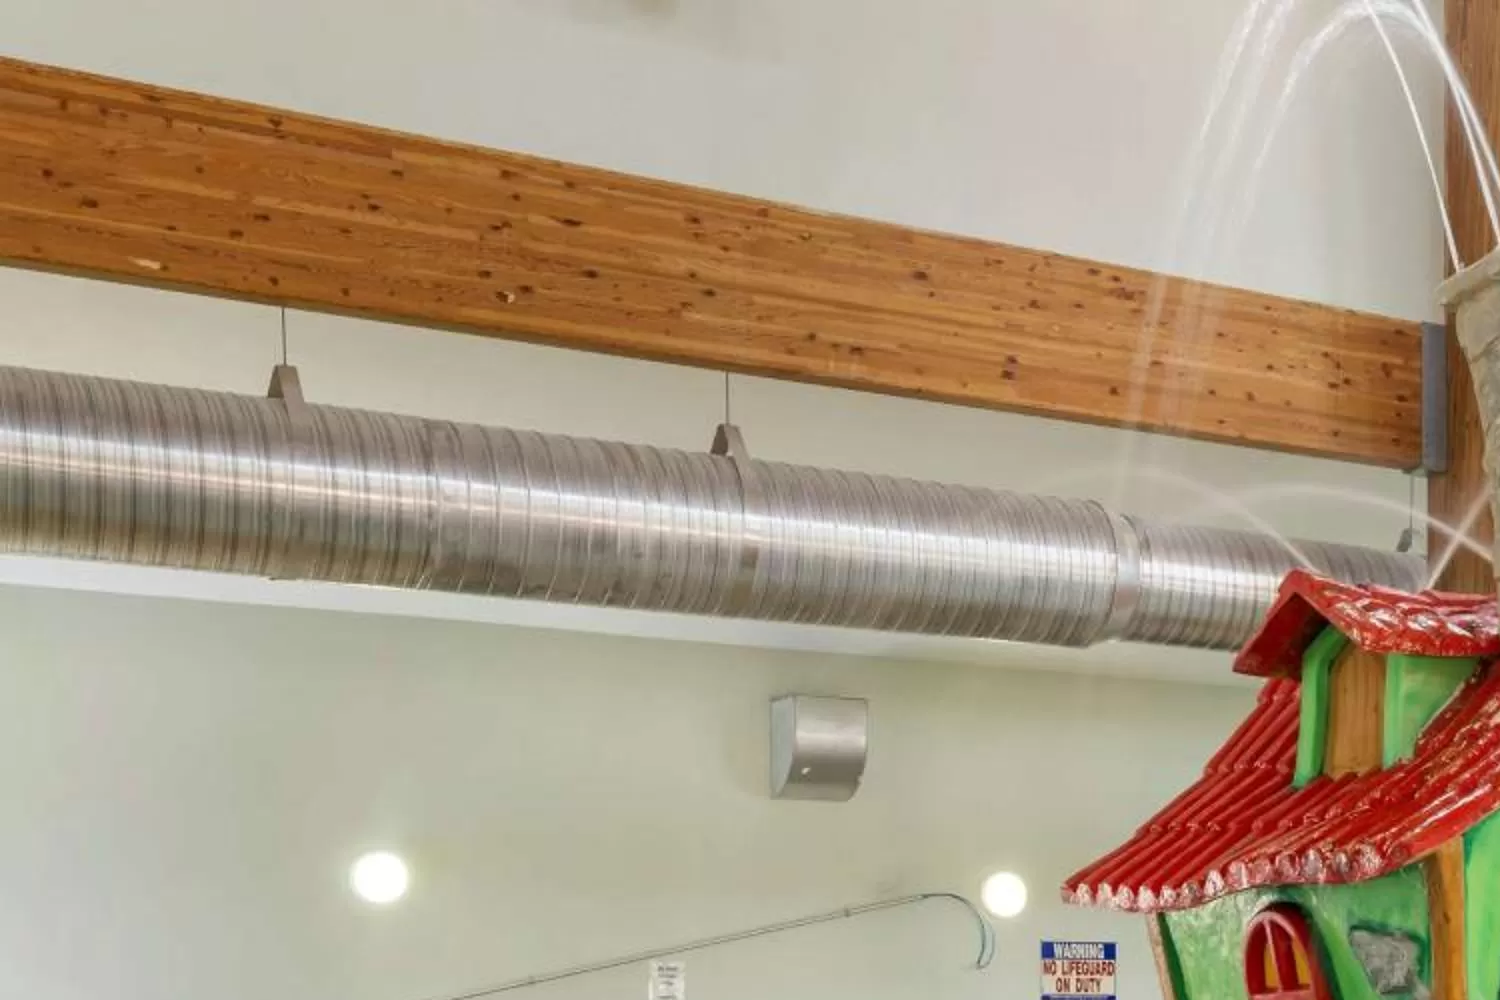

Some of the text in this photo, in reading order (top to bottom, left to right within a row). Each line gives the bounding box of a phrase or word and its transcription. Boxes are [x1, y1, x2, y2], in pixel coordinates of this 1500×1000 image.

[1053, 943, 1104, 959] WARNING
[1043, 961, 1115, 976] NO LIFEGUARD
[1056, 977, 1102, 992] ON DUTY
